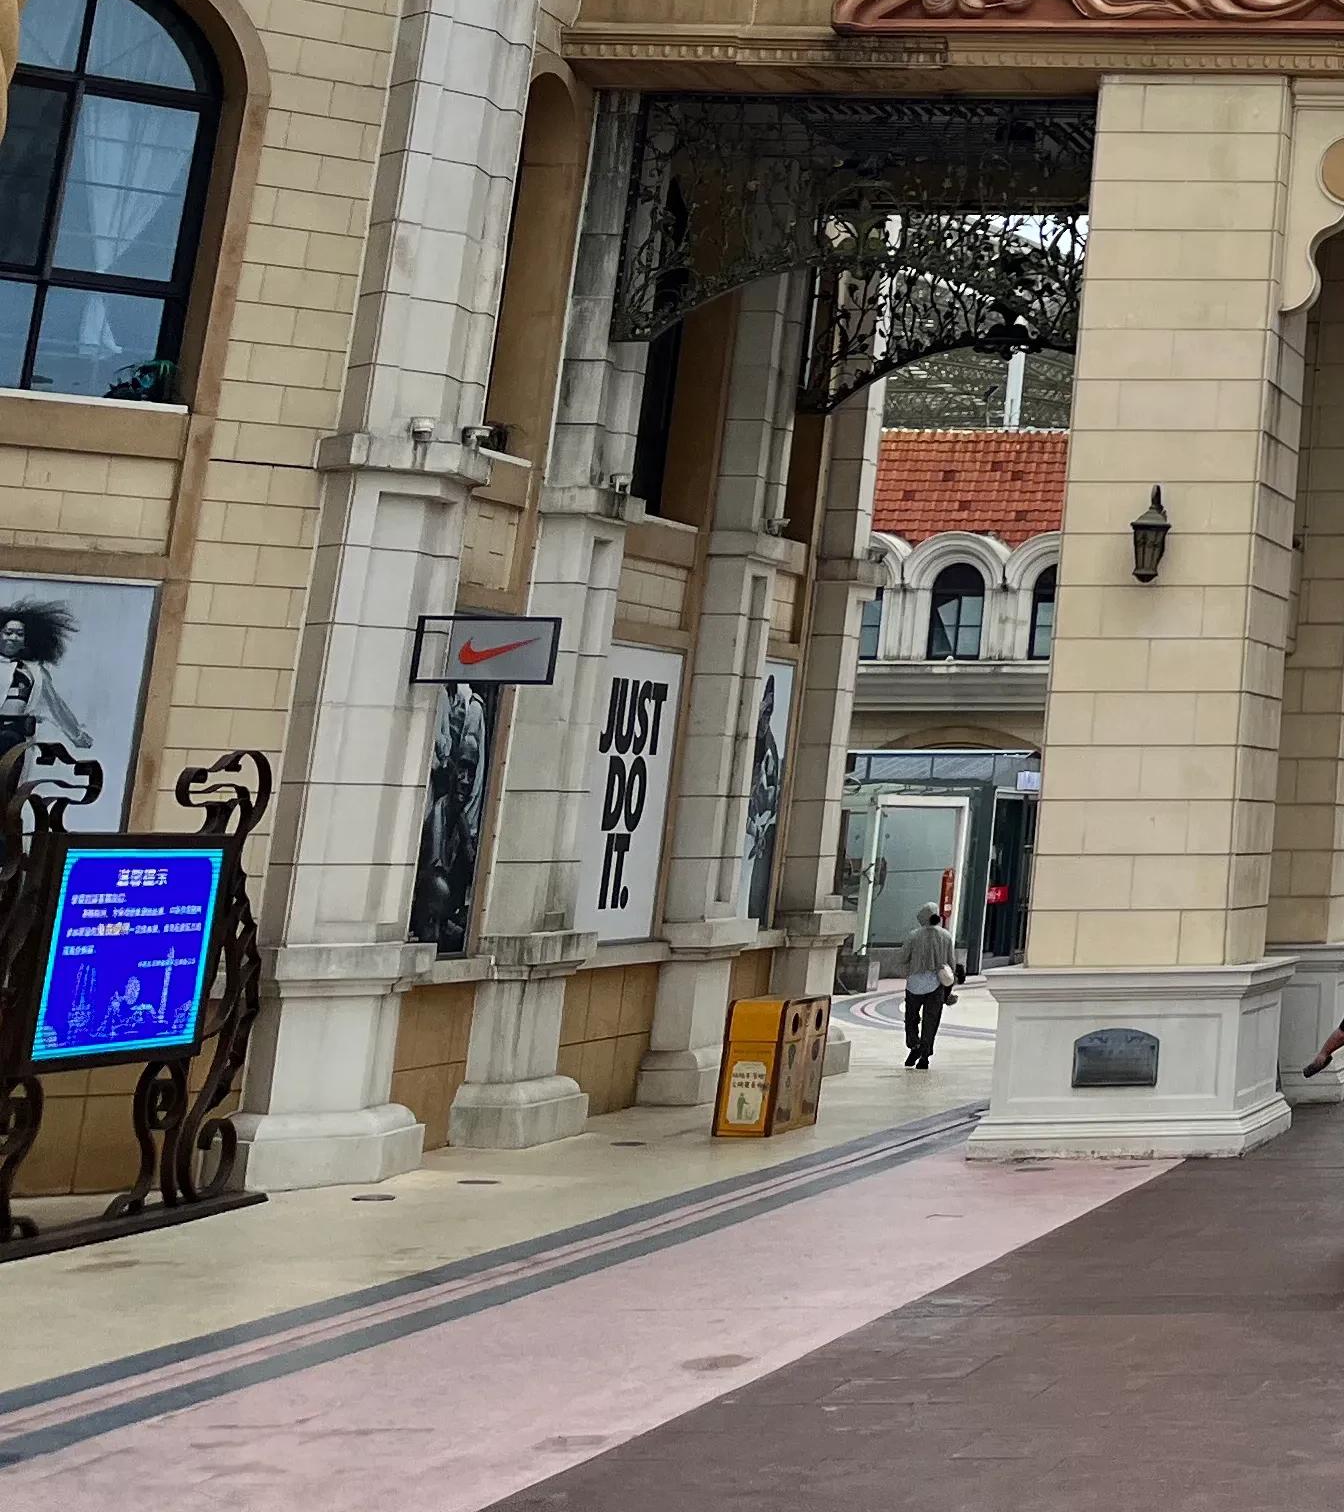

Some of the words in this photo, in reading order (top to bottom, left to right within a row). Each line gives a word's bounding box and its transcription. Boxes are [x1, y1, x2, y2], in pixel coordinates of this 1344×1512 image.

[598, 676, 669, 756] JUST
[601, 755, 648, 833] DO
[597, 833, 632, 910] IT.
